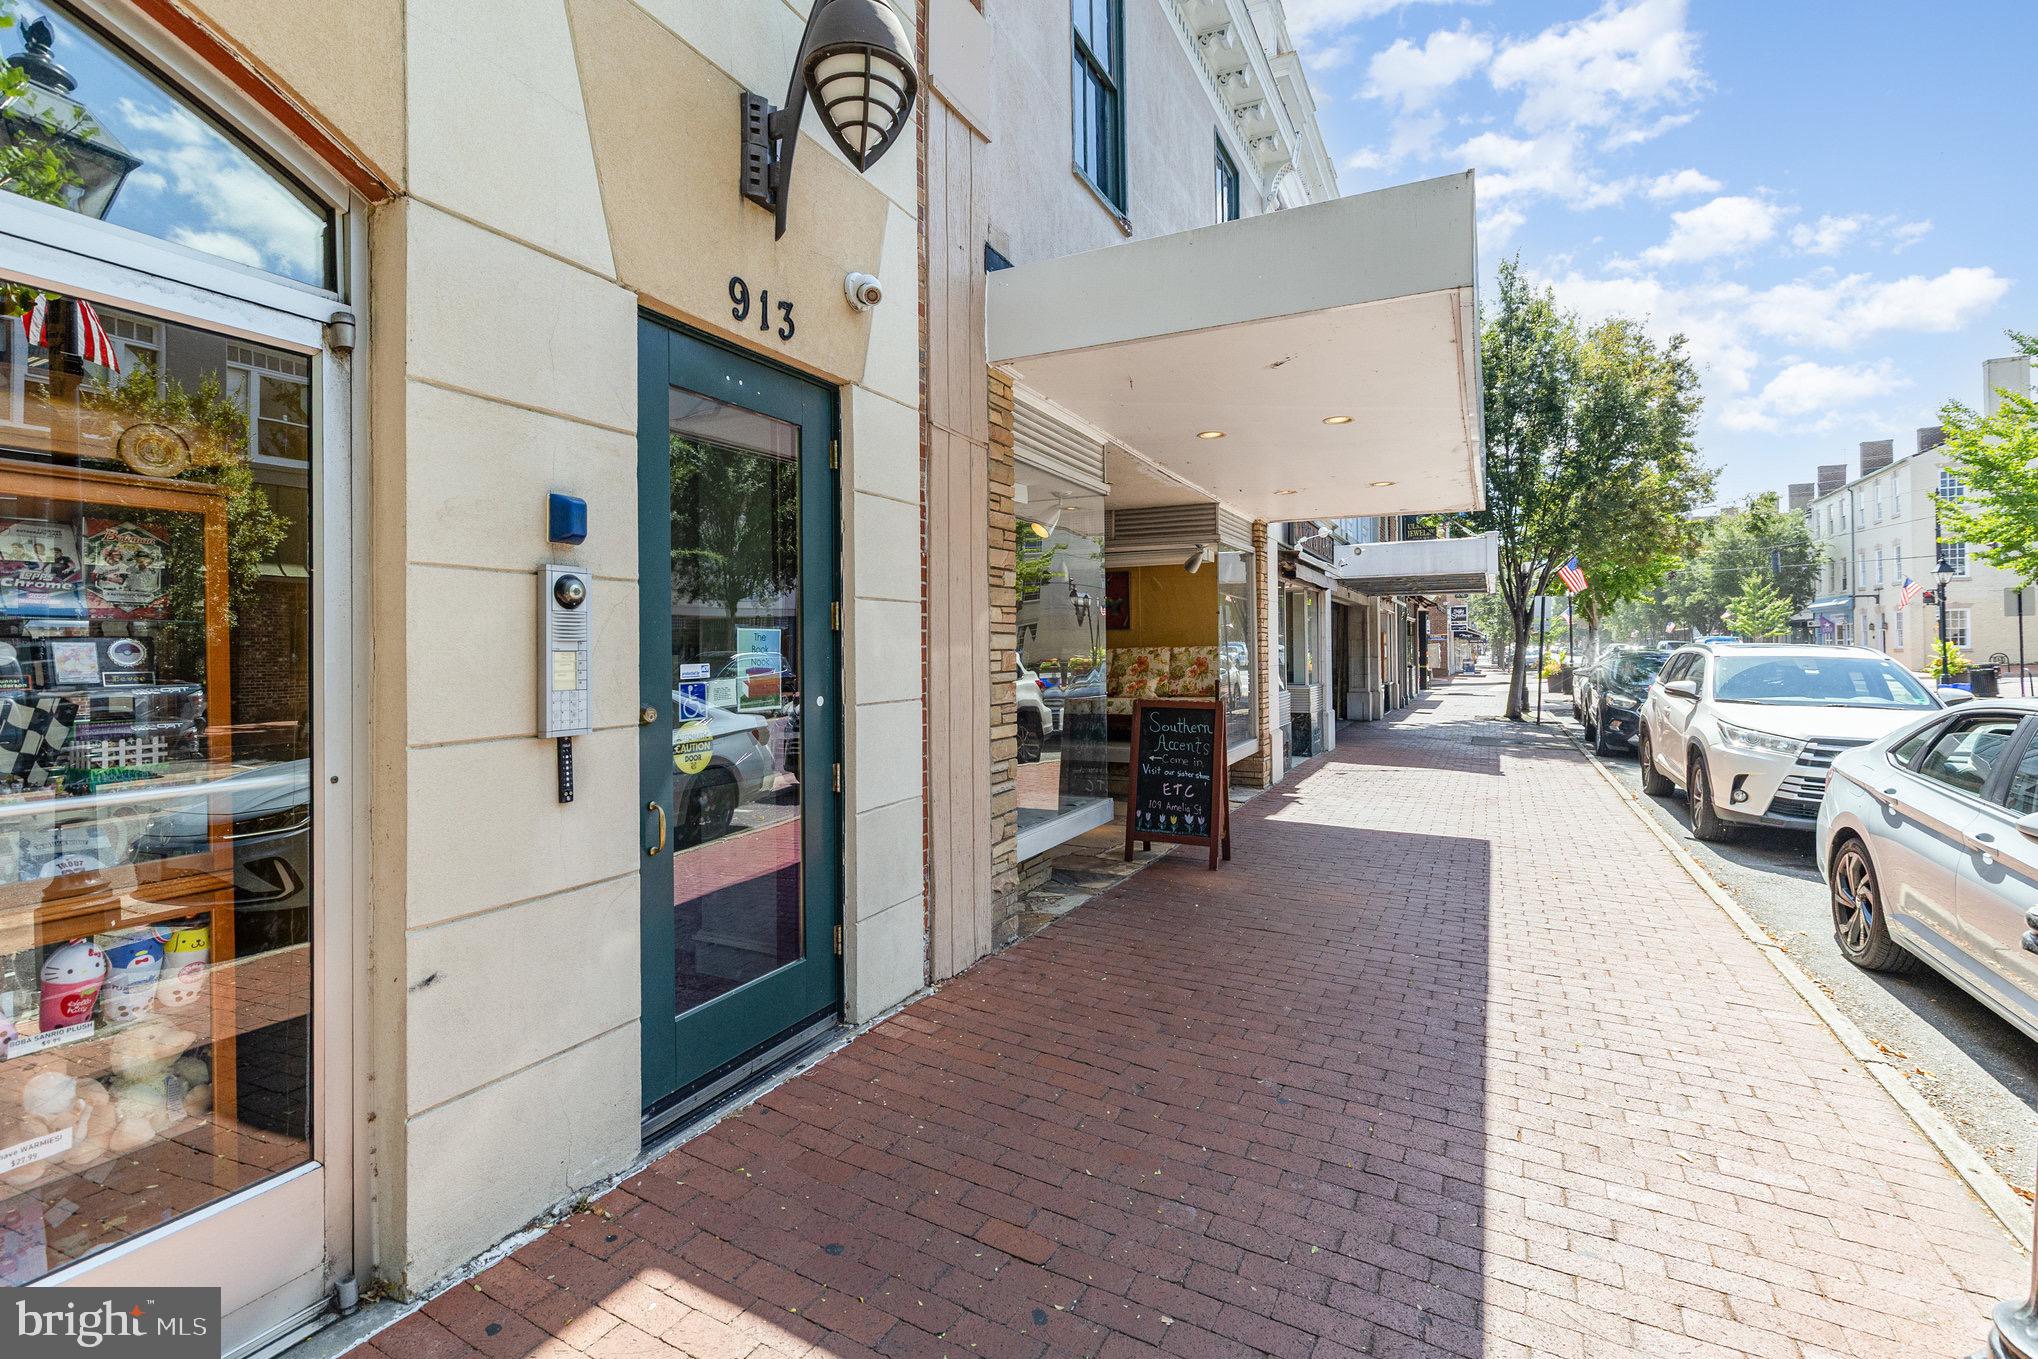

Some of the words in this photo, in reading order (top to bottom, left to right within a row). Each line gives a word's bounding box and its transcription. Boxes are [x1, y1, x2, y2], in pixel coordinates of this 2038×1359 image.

[729, 276, 795, 341] 913
[1, 577, 73, 590] Chrome
[753, 632, 767, 642] The
[751, 645, 769, 653] Book
[751, 658, 770, 666] Nook
[1149, 711, 1213, 734] Southern
[676, 741, 711, 753] CAUTION
[1153, 734, 1210, 756] Accents
[685, 754, 702, 763] DOOR
[1162, 753, 1189, 766] Come
[1142, 763, 1161, 775] Visit
[1177, 770, 1195, 779] sister
[1162, 782, 1195, 798] ETC
[1148, 799, 1162, 809] 109
[1166, 803, 1191, 813] Amelia
[67, 997, 92, 1008] Hello
[66, 1004, 88, 1016] Kitty
[10, 1037, 32, 1048] BOBA
[34, 1029, 65, 1042] SANRIO
[66, 1022, 93, 1034] PLUSH
